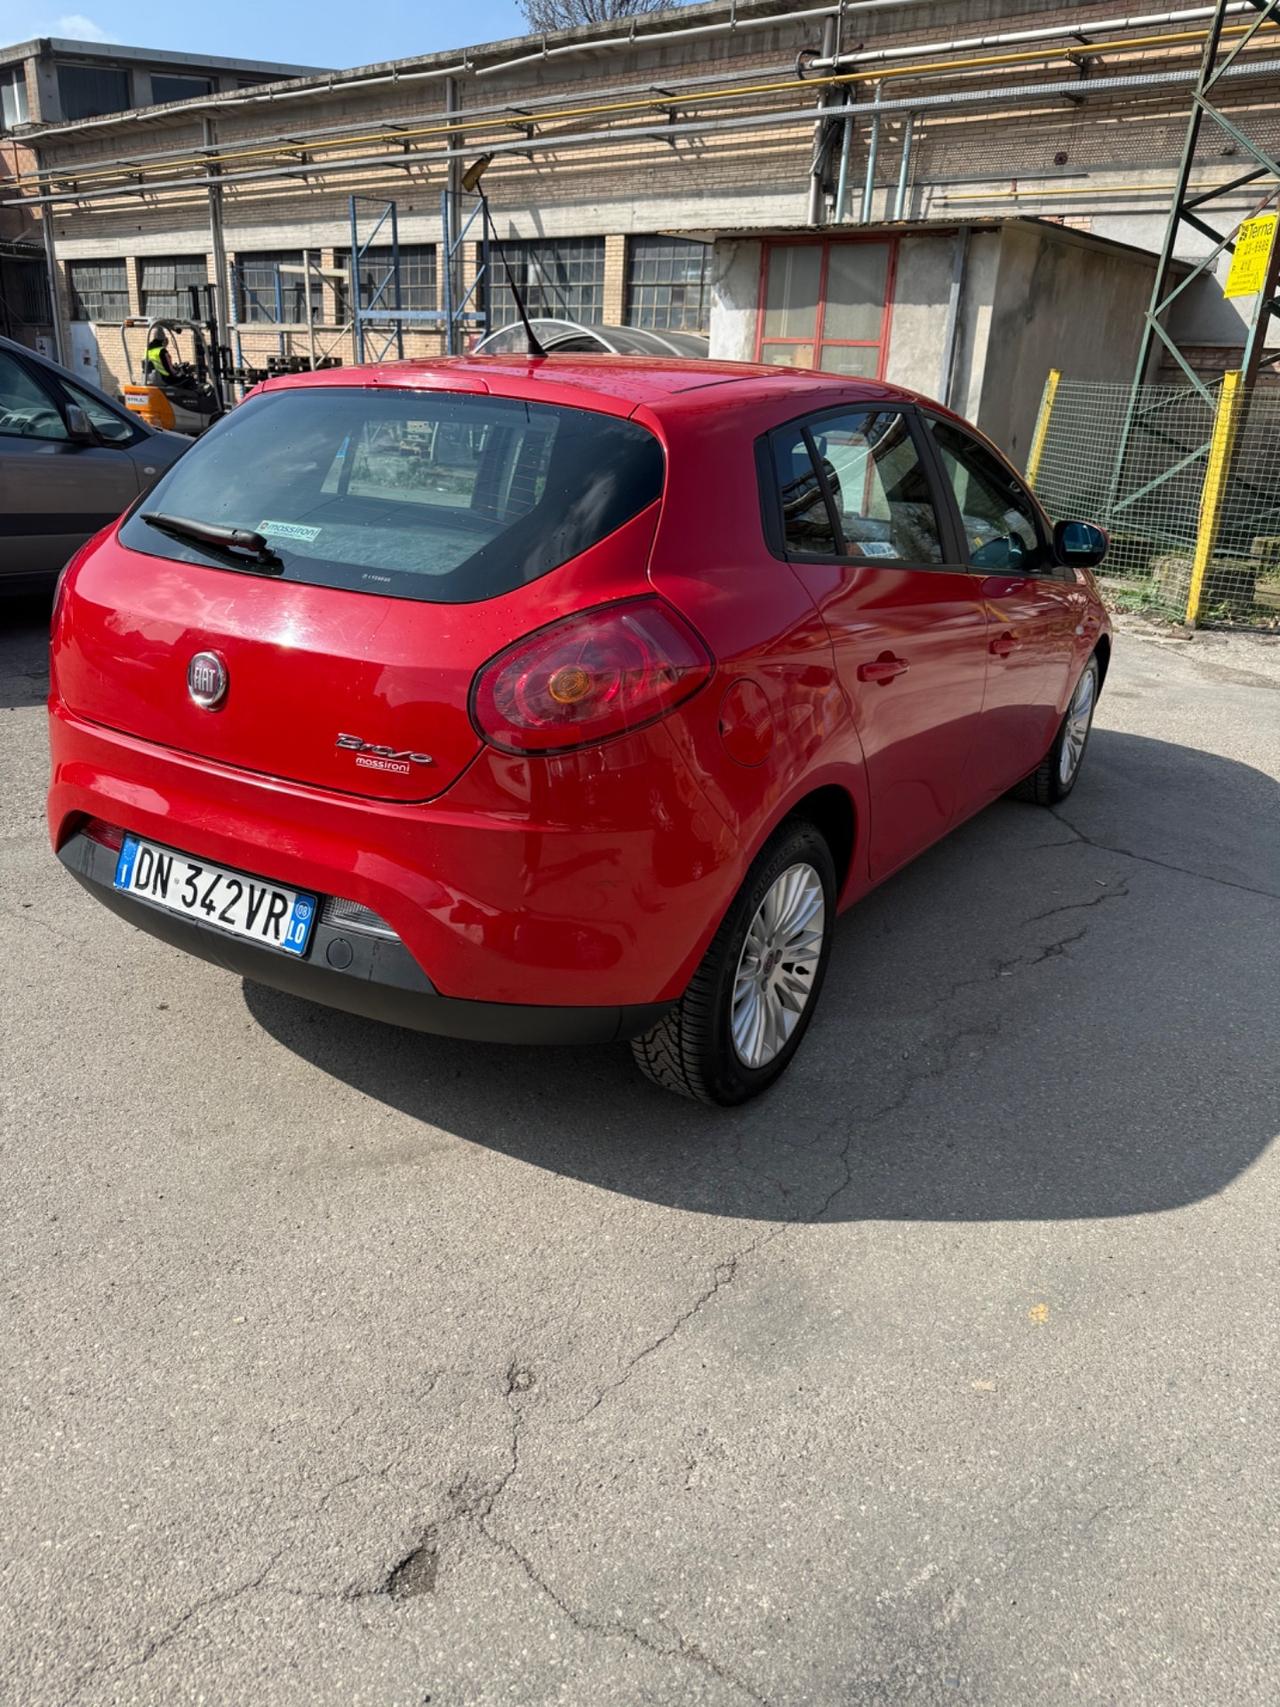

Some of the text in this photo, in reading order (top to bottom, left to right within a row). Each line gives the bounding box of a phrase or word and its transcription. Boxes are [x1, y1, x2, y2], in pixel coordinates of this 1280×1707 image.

[1249, 222, 1274, 239] Terna
[268, 523, 318, 537] massironi
[194, 667, 216, 692] FIAT
[335, 732, 433, 763] Bravo
[355, 756, 410, 772] massironi
[120, 863, 128, 883] I
[134, 847, 288, 941] DN 342VR
[297, 904, 309, 918] 08
[286, 920, 306, 945] LO
